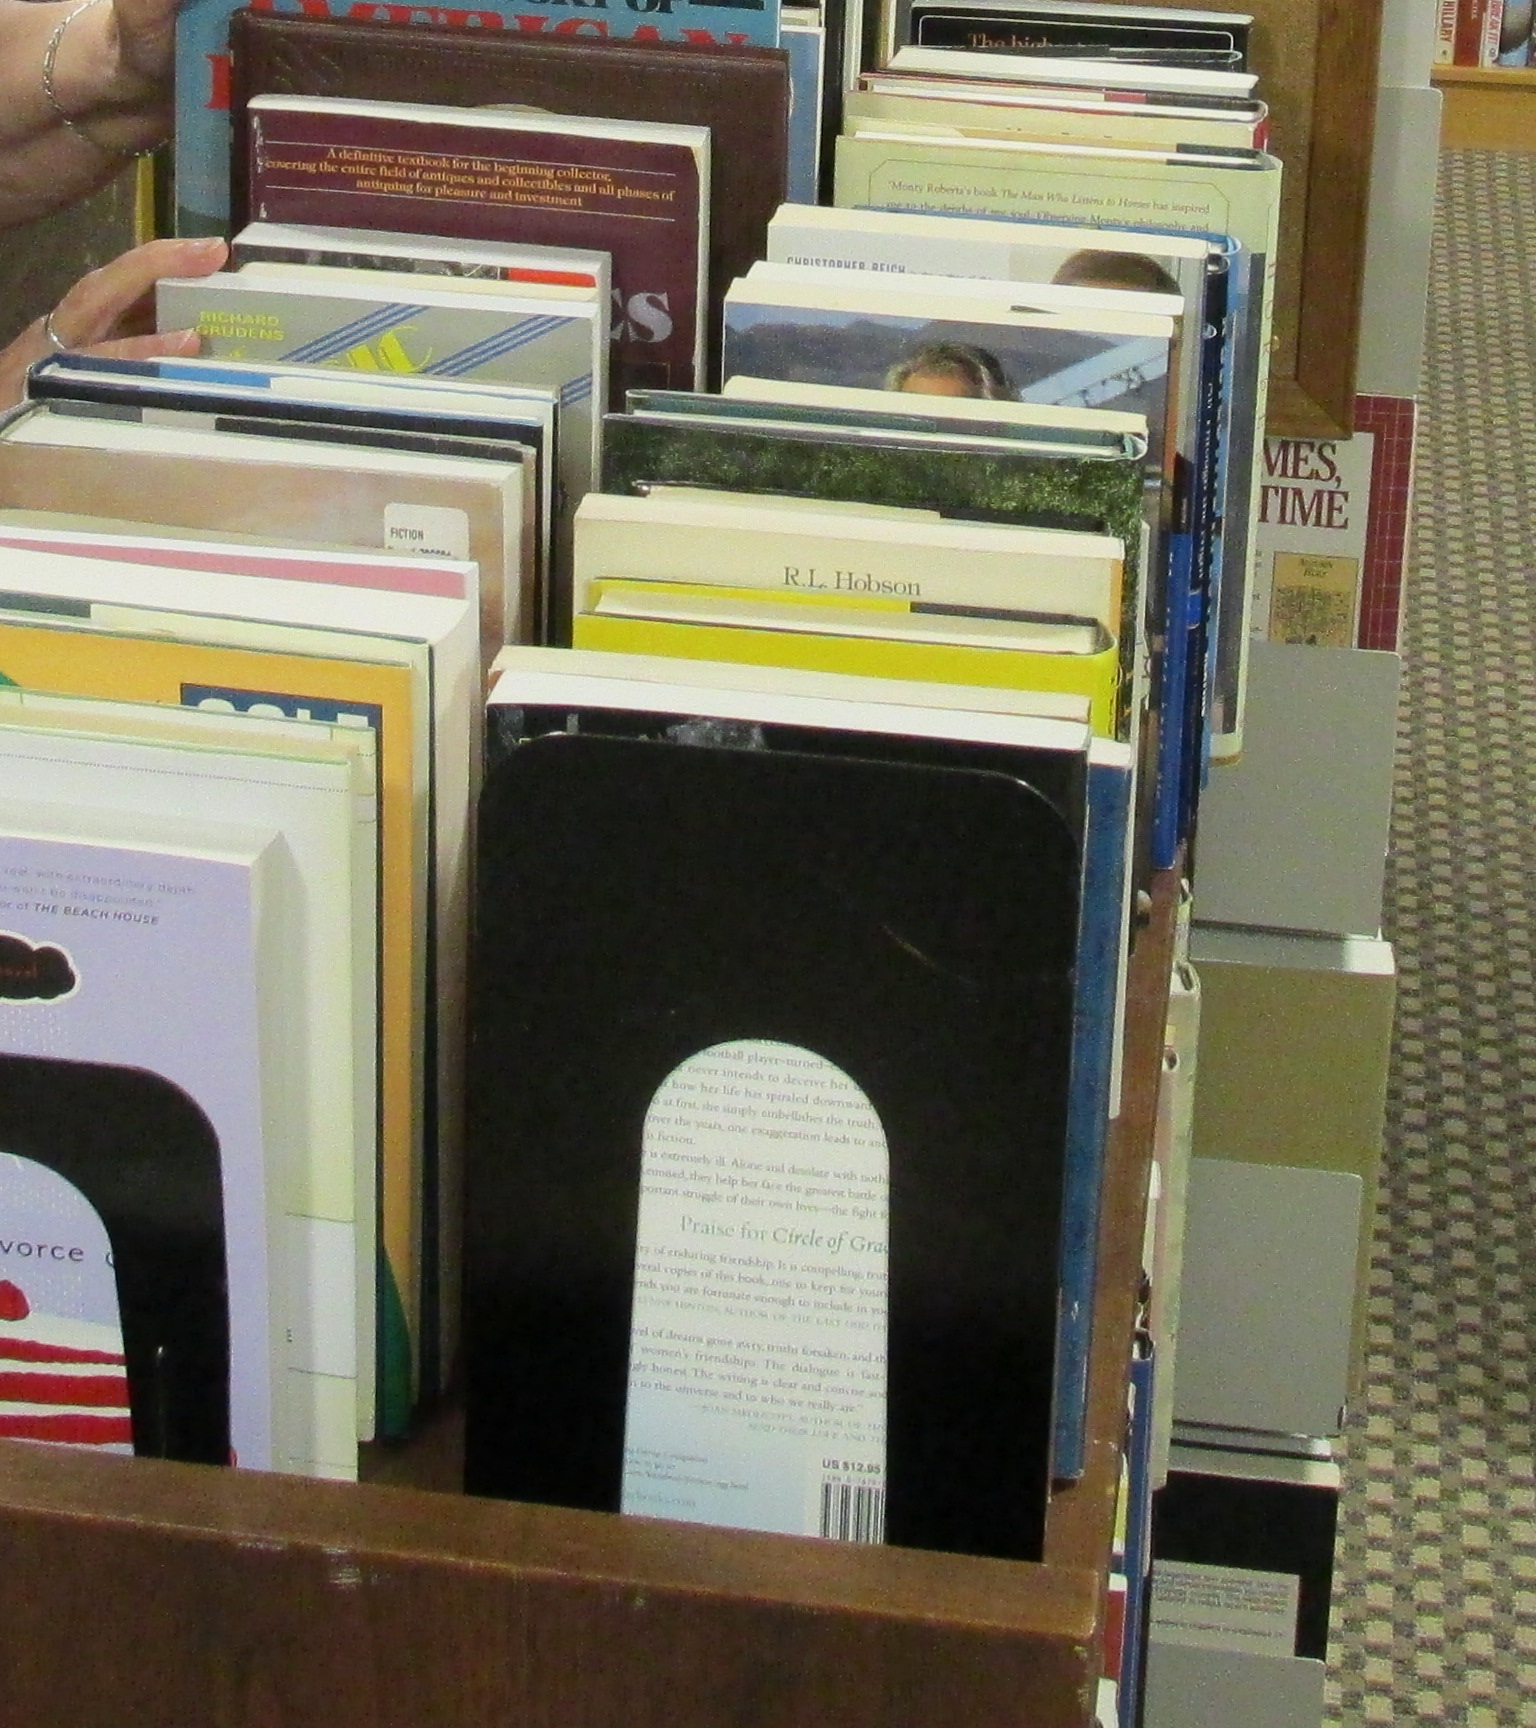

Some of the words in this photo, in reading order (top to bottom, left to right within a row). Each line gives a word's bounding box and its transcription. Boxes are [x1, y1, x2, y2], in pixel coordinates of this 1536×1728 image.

[1439, 1, 1456, 43] HILLARY
[328, 148, 337, 158] A
[339, 151, 394, 165] definitive
[397, 154, 448, 168] textbook
[449, 158, 470, 170] for
[472, 159, 492, 171] the
[494, 161, 554, 178] beginning
[556, 167, 612, 182] collector,
[265, 161, 318, 175] covering
[319, 161, 339, 172] the
[341, 164, 377, 176] entire
[379, 165, 407, 177] field
[409, 168, 421, 179] of
[421, 170, 475, 185] antiques
[477, 174, 500, 186] and
[502, 175, 572, 192] collectibles
[574, 182, 597, 194] and
[599, 183, 615, 195] all
[617, 186, 661, 201] phases
[662, 189, 676, 202] of
[356, 178, 414, 195] antiquing
[415, 182, 433, 194] for
[435, 184, 488, 200] pleasure
[489, 189, 512, 201] and
[513, 191, 583, 206] investment
[196, 324, 285, 341] GRUDENS
[200, 311, 279, 327] RICHARD
[389, 526, 426, 542] FICTION
[783, 566, 827, 589] R.L.
[834, 570, 922, 598] Hobson
[34, 902, 58, 914] THE
[64, 906, 109, 920] BEACH
[113, 911, 159, 925] HOUSE
[681, 1216, 735, 1237] Praise
[741, 1221, 767, 1241] for
[773, 1227, 822, 1251] Circle
[827, 1231, 849, 1257] of
[822, 1459, 840, 1471] US
[842, 1460, 882, 1475] $12.95
